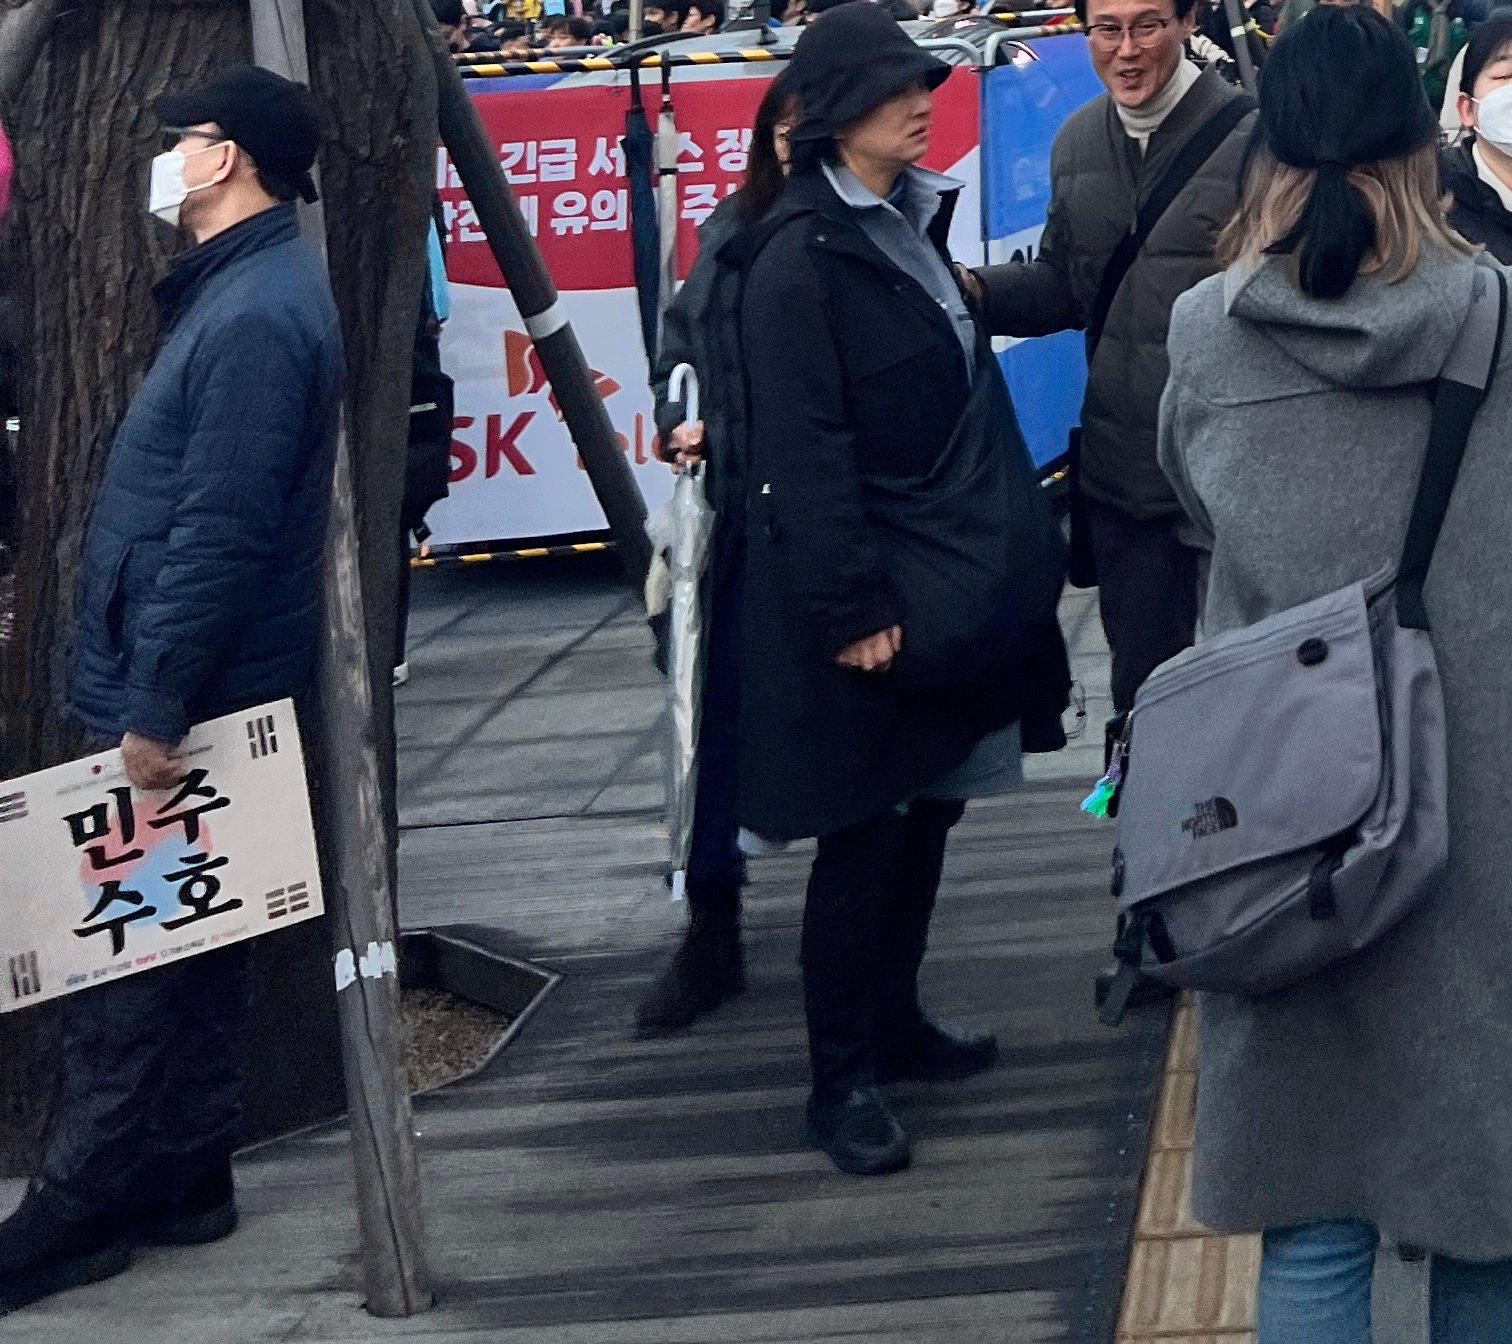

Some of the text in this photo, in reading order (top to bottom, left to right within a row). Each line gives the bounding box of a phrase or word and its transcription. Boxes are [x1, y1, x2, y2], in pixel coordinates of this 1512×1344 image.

[499, 138, 578, 185] 긴급
[588, 131, 705, 178] 서스
[550, 188, 659, 236] 유의
[681, 182, 741, 227] 주
[448, 411, 536, 484] SK
[61, 768, 230, 870] 민주
[72, 852, 243, 957] 수호
